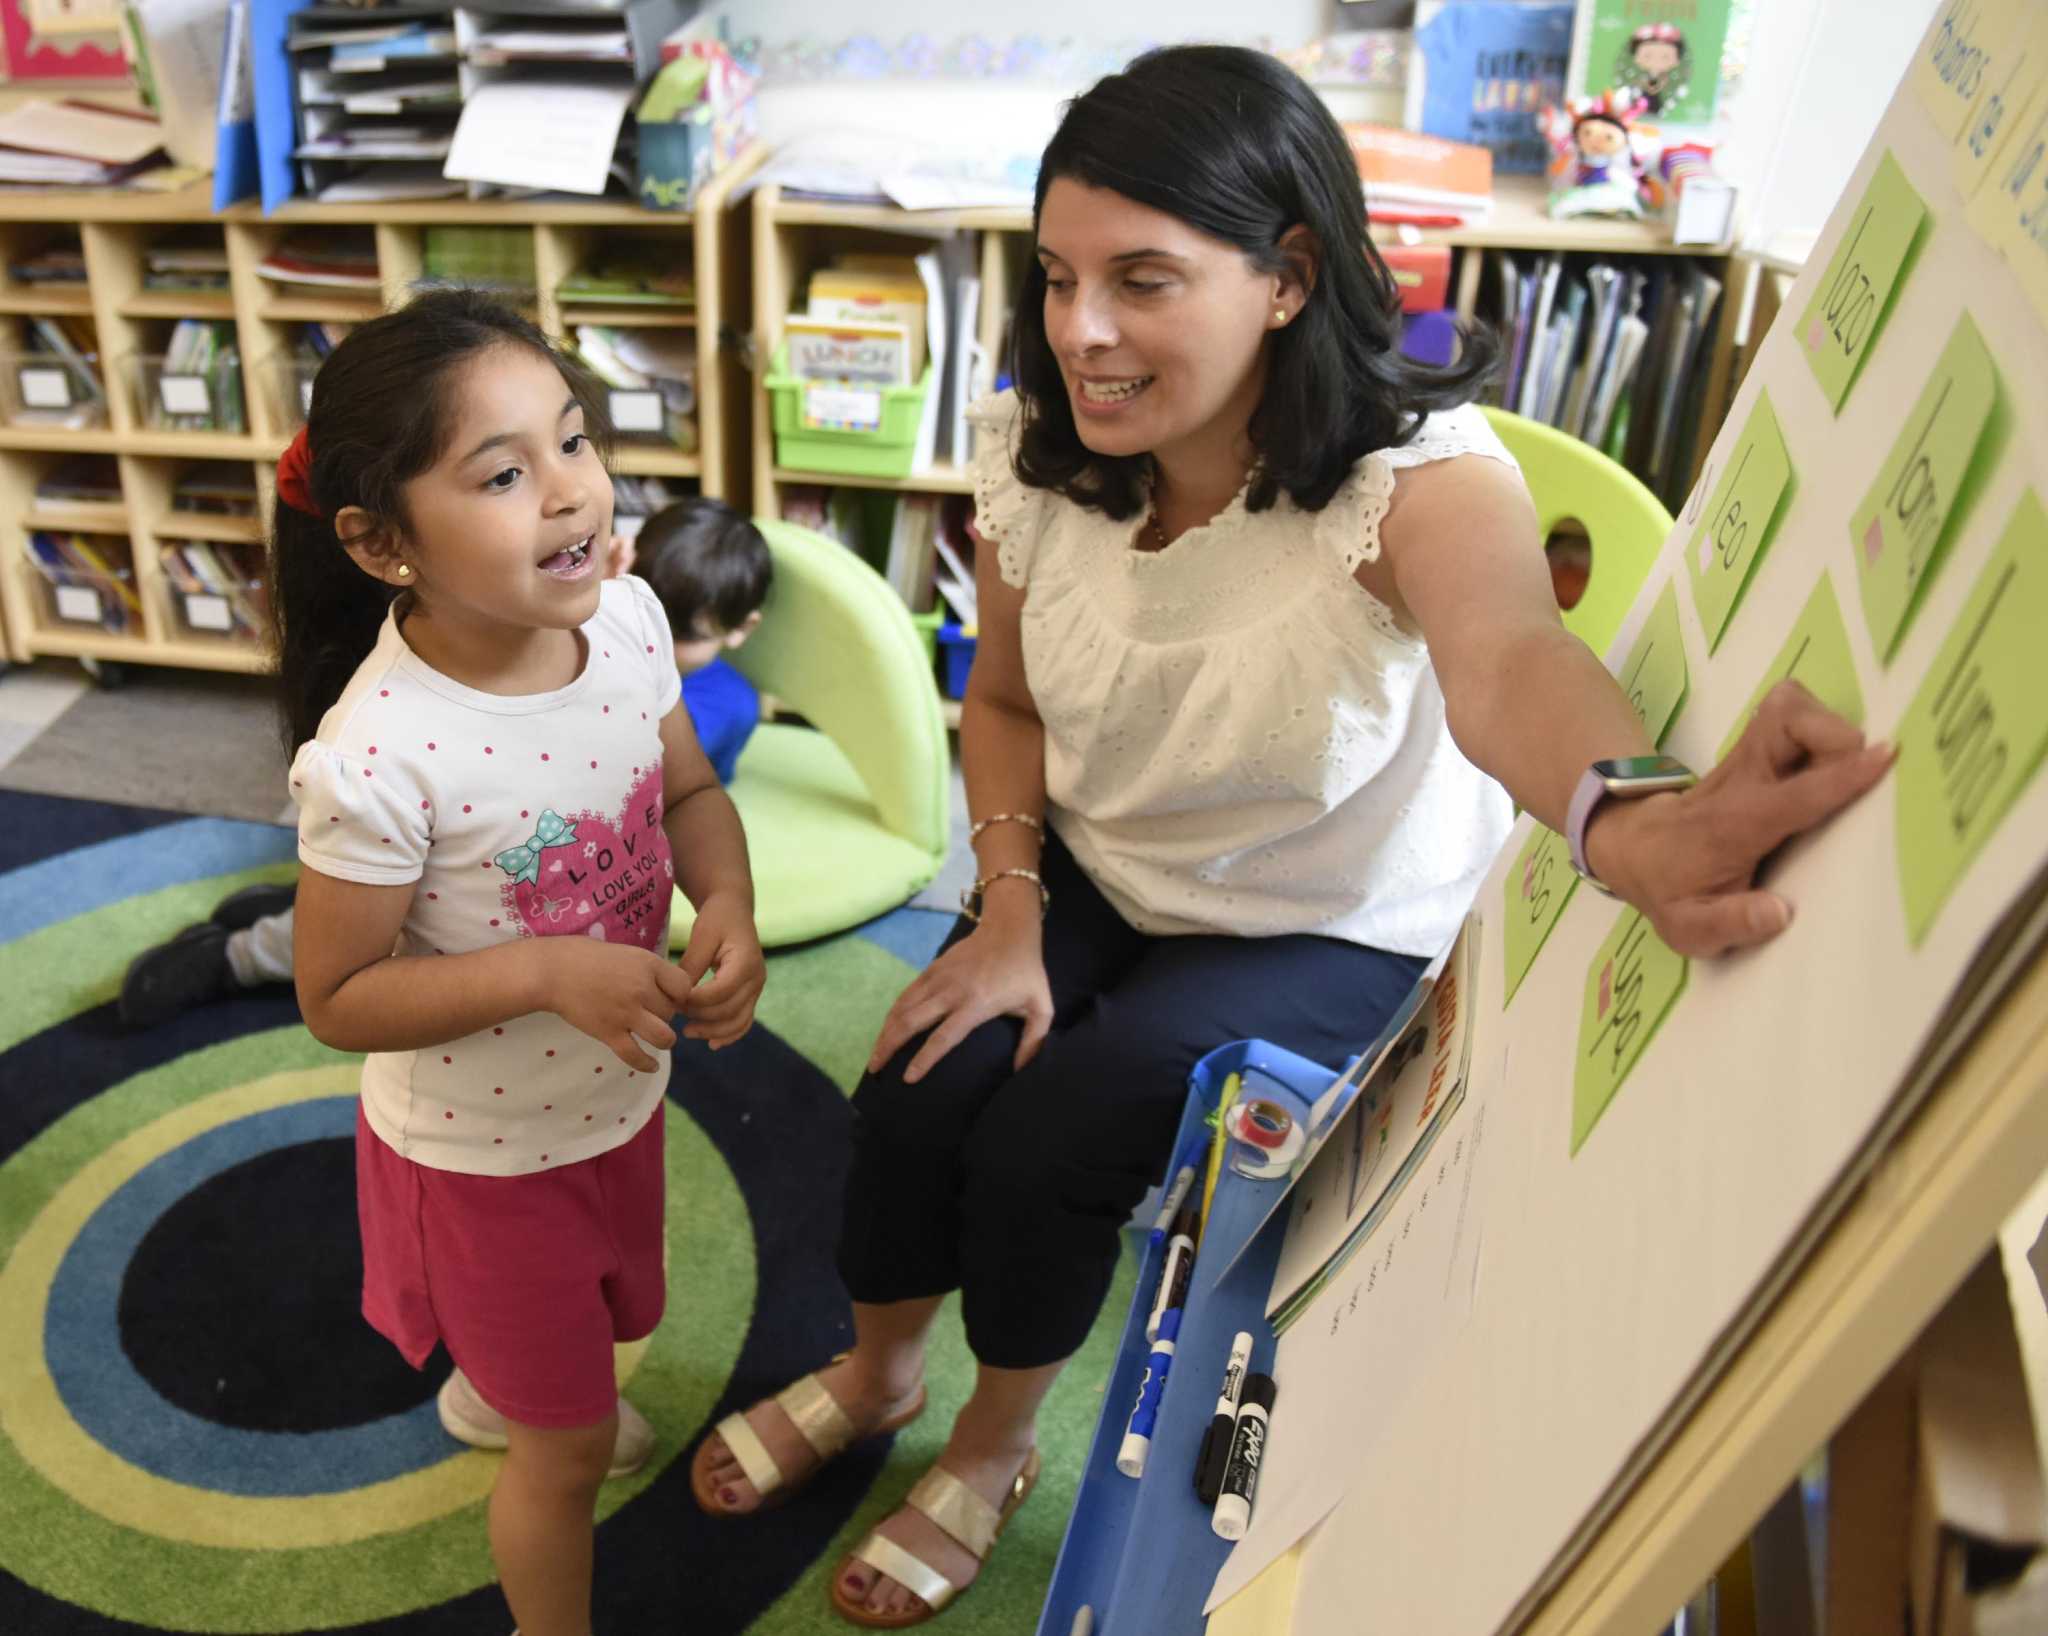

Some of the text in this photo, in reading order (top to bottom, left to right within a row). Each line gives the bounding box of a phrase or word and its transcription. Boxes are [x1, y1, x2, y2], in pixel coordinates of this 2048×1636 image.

[1821, 205, 1875, 357] lazo
[1711, 442, 1756, 571] leo
[568, 804, 657, 885] LOVE
[592, 848, 658, 907] LOVE YOU
